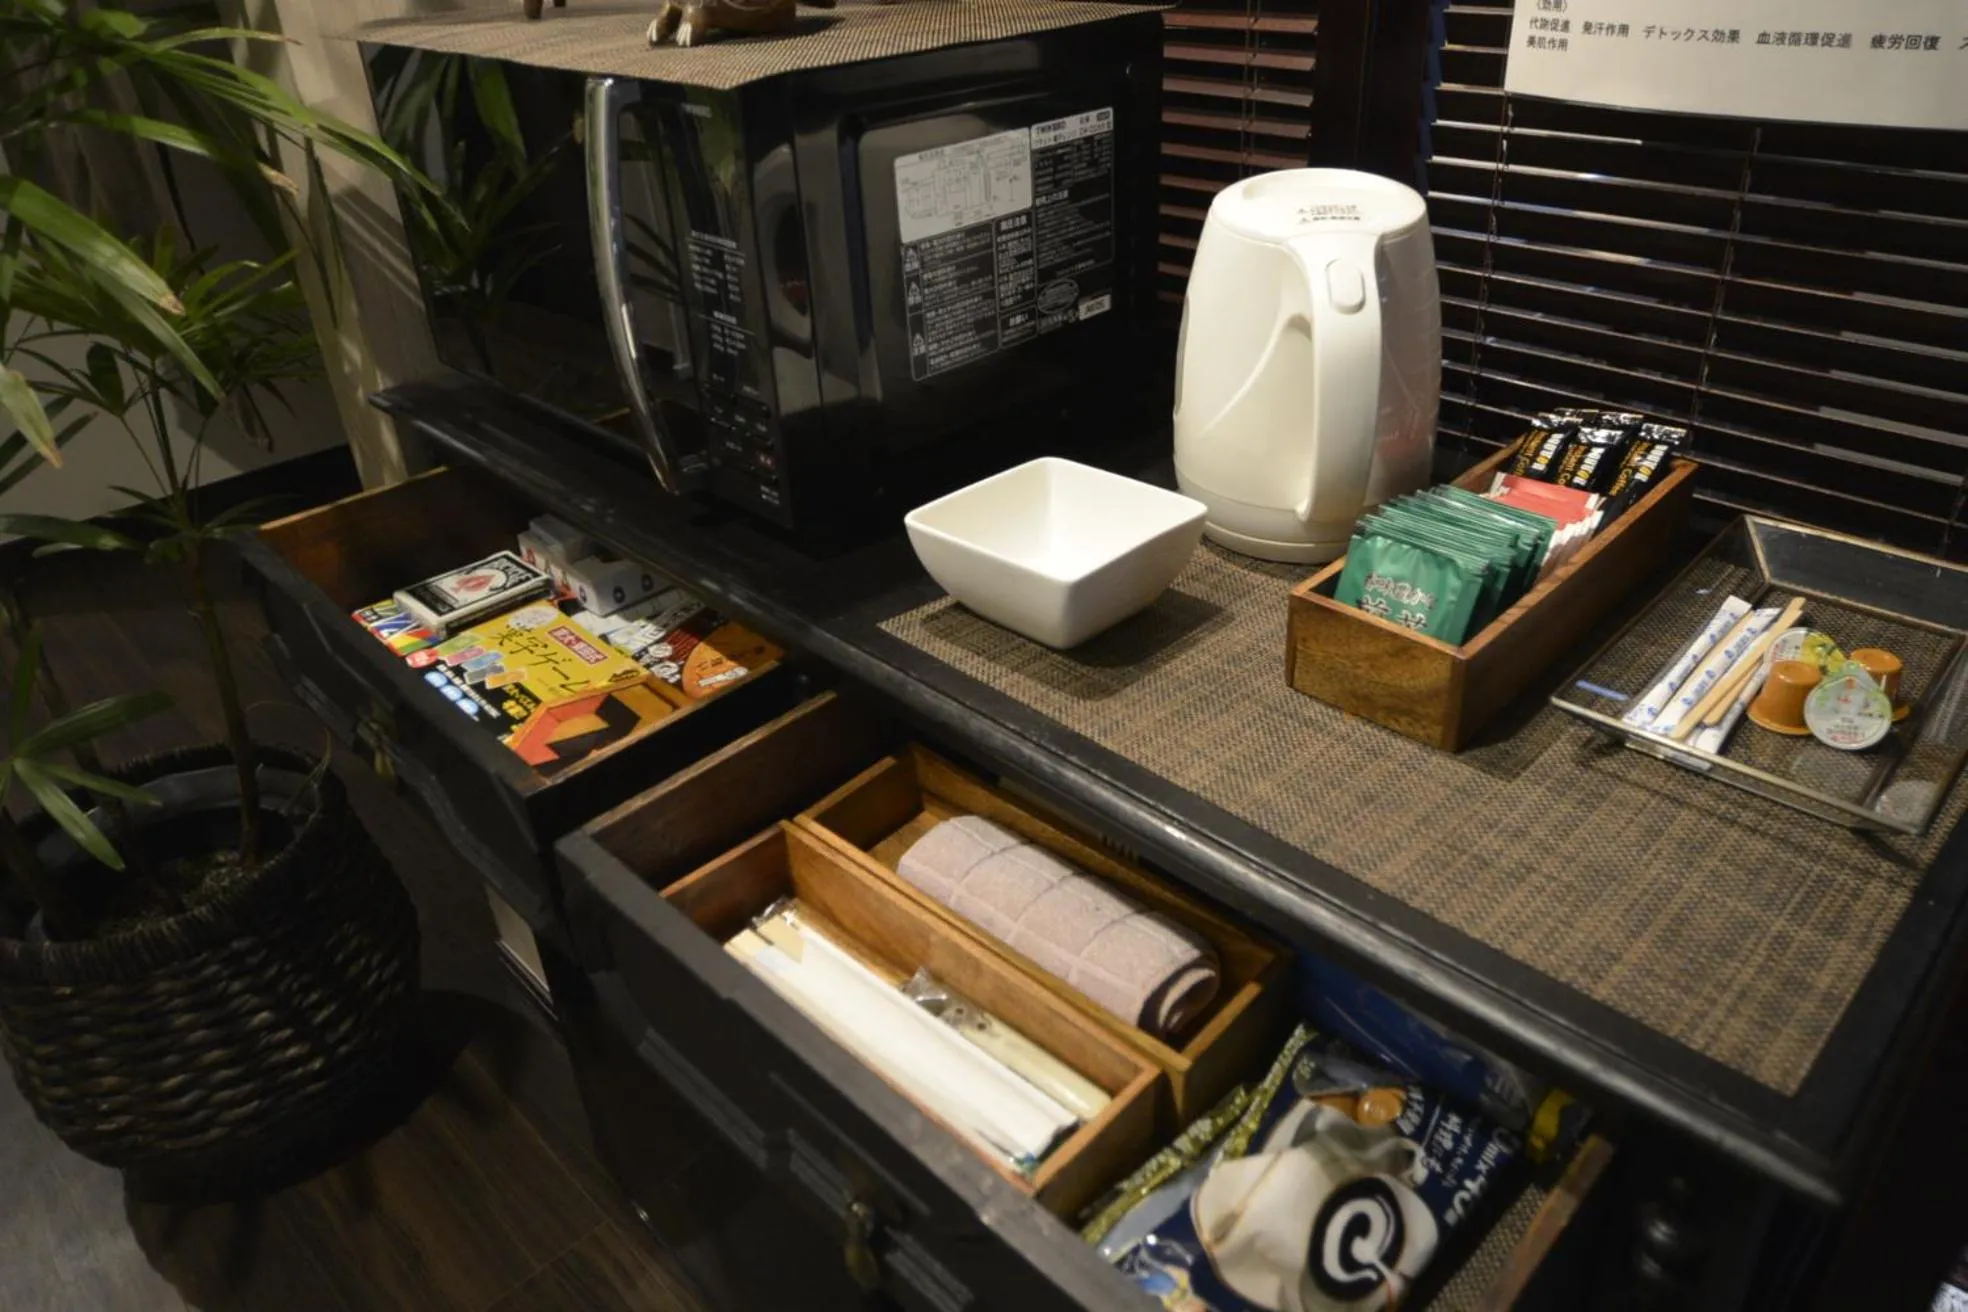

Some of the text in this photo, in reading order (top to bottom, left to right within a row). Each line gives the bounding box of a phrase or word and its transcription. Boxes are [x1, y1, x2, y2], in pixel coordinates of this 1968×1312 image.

[1526, 35, 1568, 51] 美肌作用
[1582, 20, 1630, 38] 発汗作用
[1643, 25, 1741, 44] デトックス効果
[1756, 31, 1853, 48] 血液循環促進
[1870, 33, 1941, 50] 疲労回復
